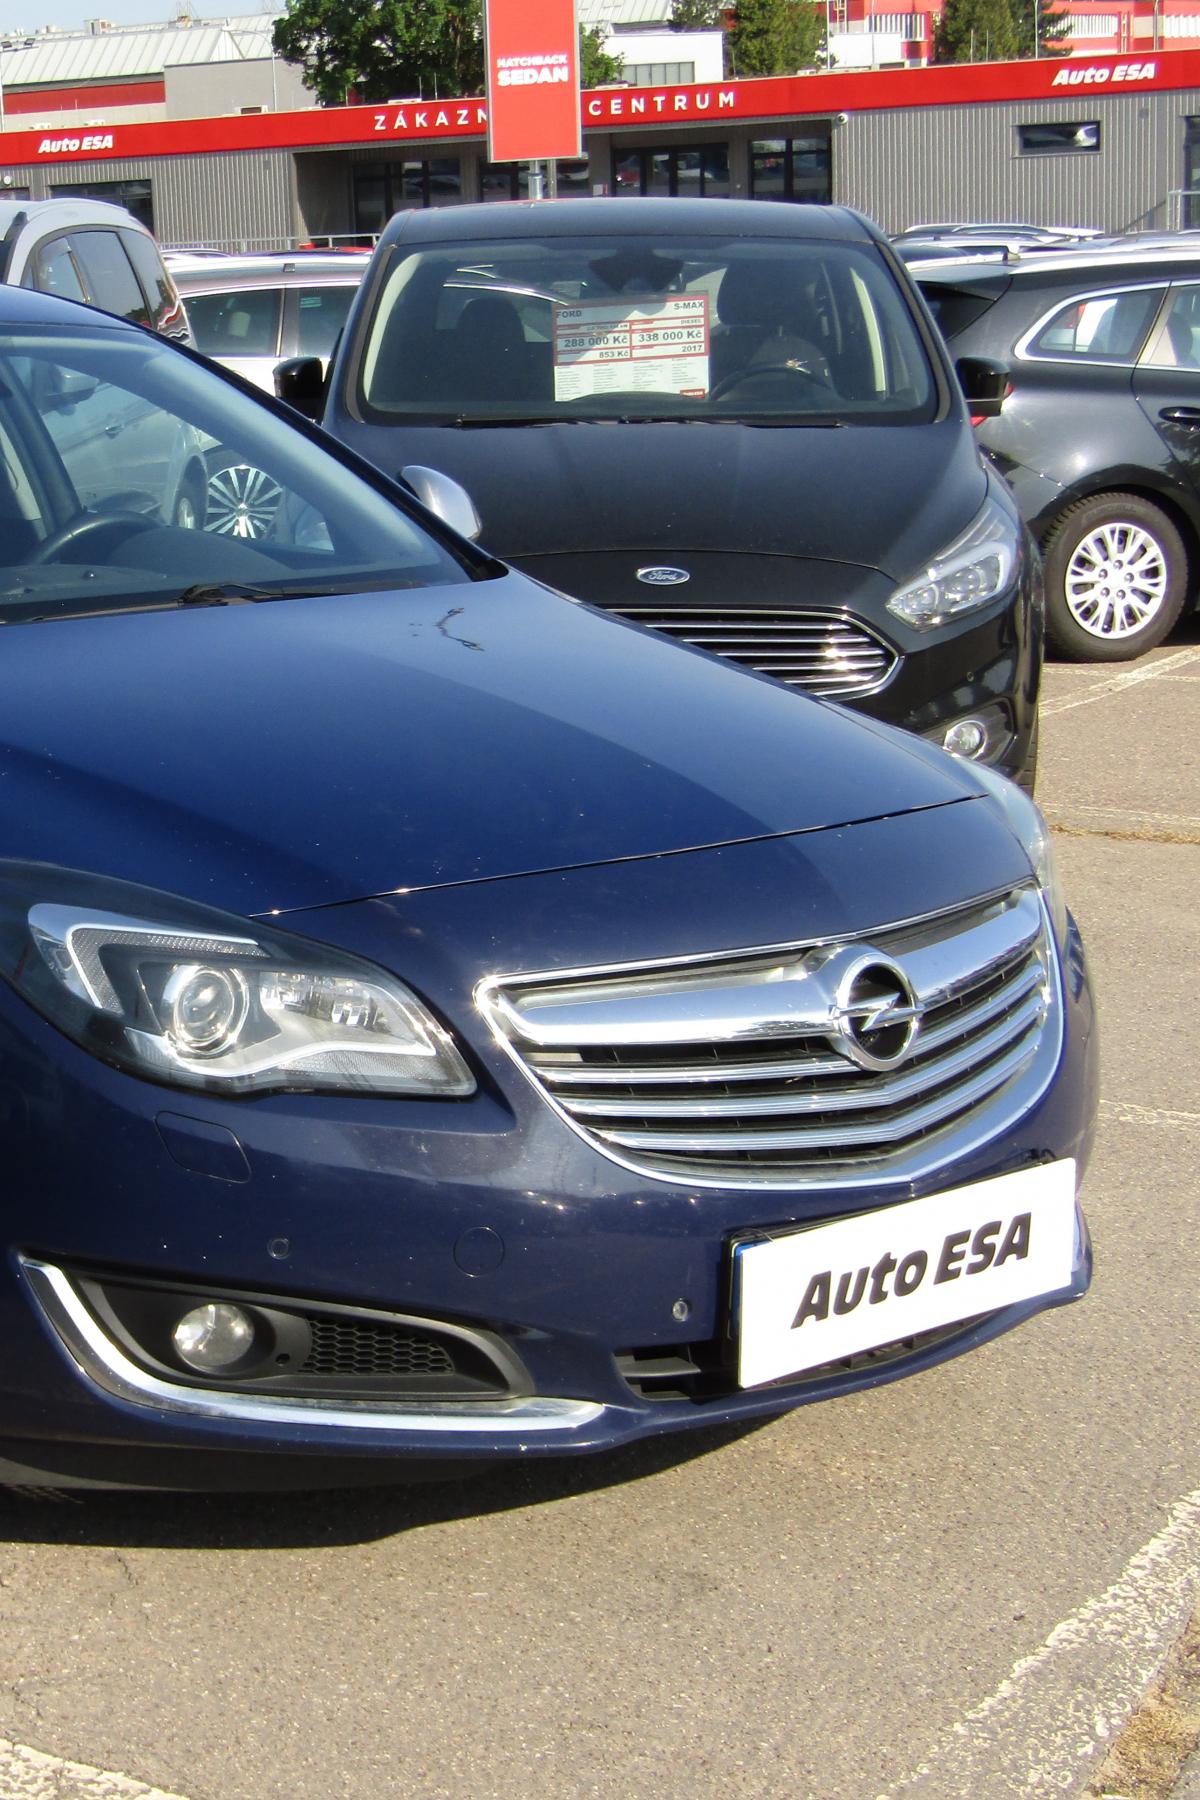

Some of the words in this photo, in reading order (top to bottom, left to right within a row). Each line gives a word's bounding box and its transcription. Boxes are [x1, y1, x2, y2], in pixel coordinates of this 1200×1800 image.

[497, 54, 567, 68] HATCHBACK
[497, 66, 568, 86] SEDAN
[1051, 67, 1110, 86] Auto
[1111, 63, 1156, 82] ESA
[588, 91, 734, 116] CENTRUM
[38, 138, 80, 154] Auto
[81, 135, 113, 150] ESA
[556, 310, 582, 318] FORD
[673, 301, 704, 310] S-MAX
[564, 338, 585, 348] 288
[588, 336, 609, 346] 000
[613, 334, 628, 344] Kč
[638, 332, 659, 343] 338
[662, 330, 683, 341] 000
[687, 329, 702, 339] Kč
[599, 351, 615, 359] 853
[617, 349, 629, 357] Kč
[681, 345, 702, 353] 2017
[790, 1249, 928, 1330] Auto
[933, 1212, 1031, 1285] ESA
